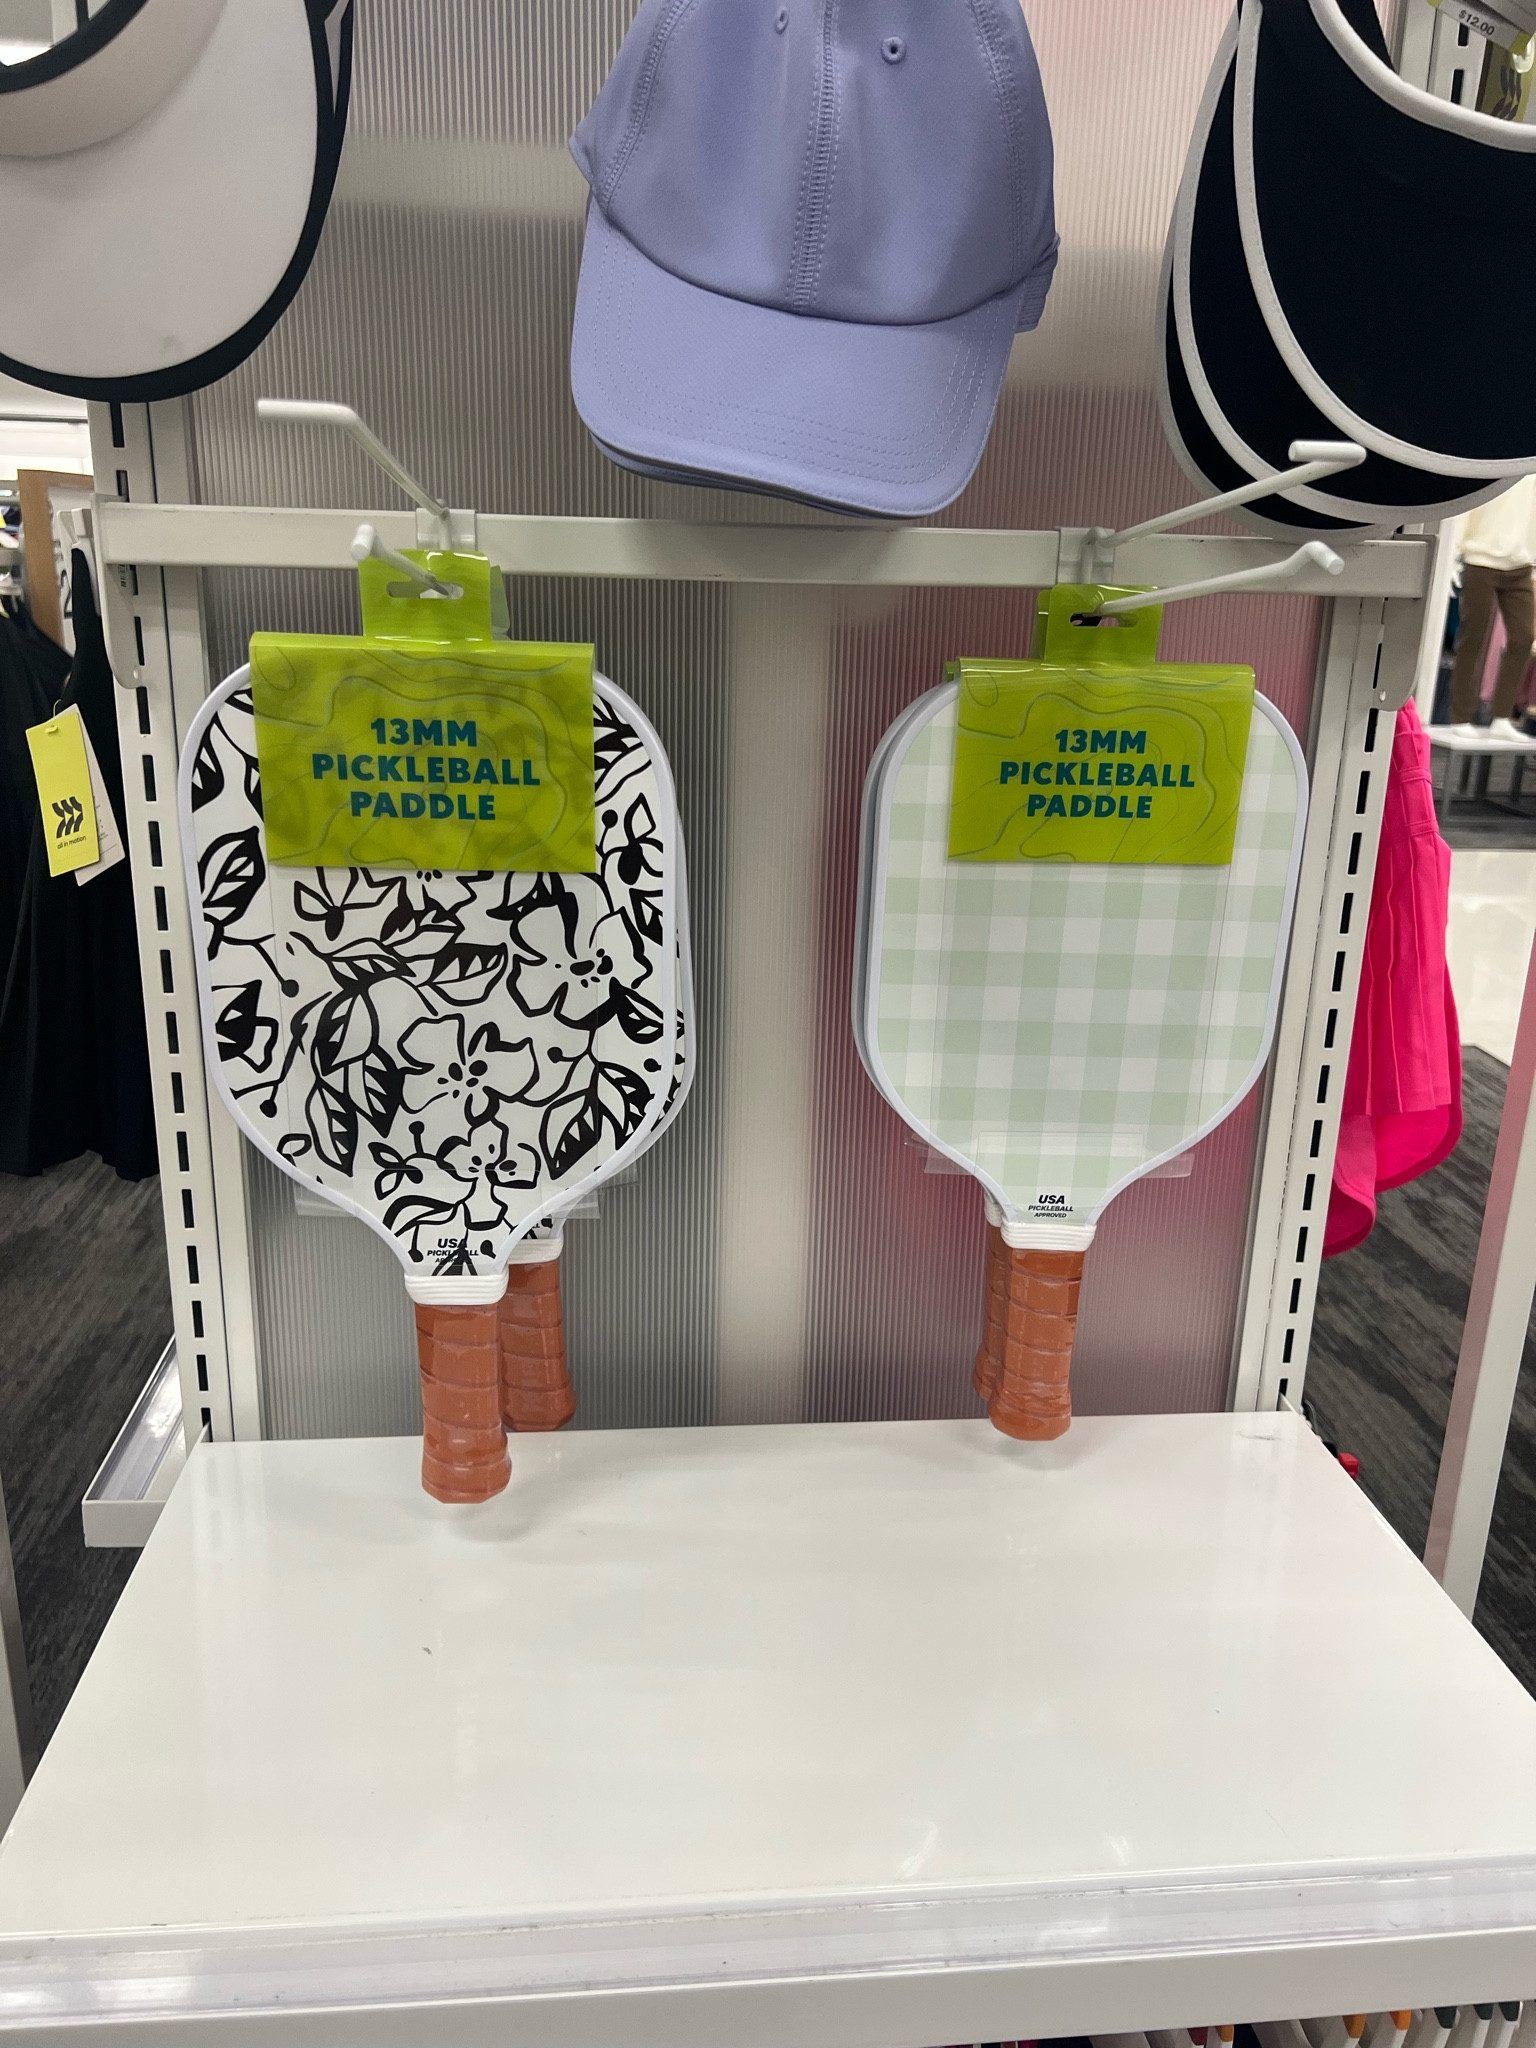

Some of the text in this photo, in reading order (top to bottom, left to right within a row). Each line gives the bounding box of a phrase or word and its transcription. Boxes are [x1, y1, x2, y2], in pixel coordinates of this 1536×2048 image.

[1458, 9, 1495, 36] $12.00
[370, 718, 477, 748] 13MM
[1055, 729, 1147, 754] 13MM
[311, 752, 541, 786] PICKLEBALL
[999, 761, 1195, 788] PICKLEBALL
[350, 790, 497, 821] PADDLE
[1026, 793, 1153, 818] PADDLE
[69, 835, 87, 845] motion
[1038, 1194, 1066, 1205] USA
[437, 1238, 467, 1248] USA
